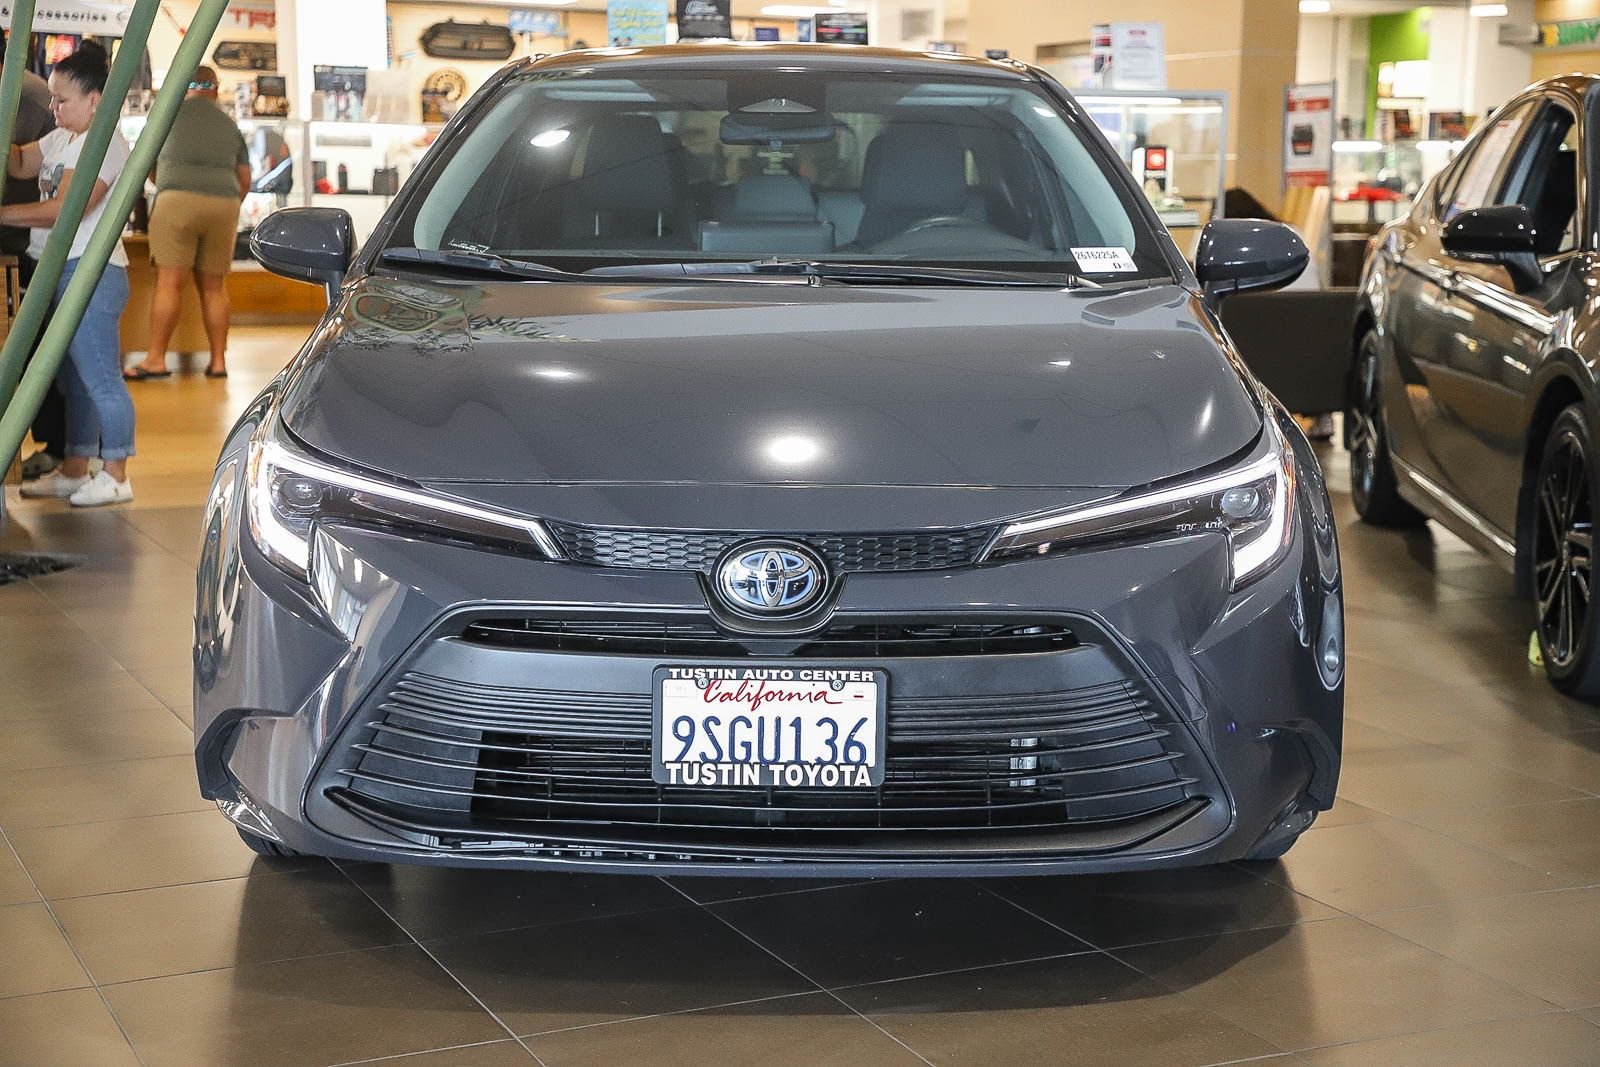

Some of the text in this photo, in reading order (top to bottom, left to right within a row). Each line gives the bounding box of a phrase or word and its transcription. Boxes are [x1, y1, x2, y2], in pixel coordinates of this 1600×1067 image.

[36, 9, 109, 22] cessories
[669, 668, 874, 681] TUSTIN AUTO CENTER
[704, 679, 843, 711] California
[672, 715, 868, 765] 9SGU136
[665, 762, 873, 786] TUSTIN TOYOTA
